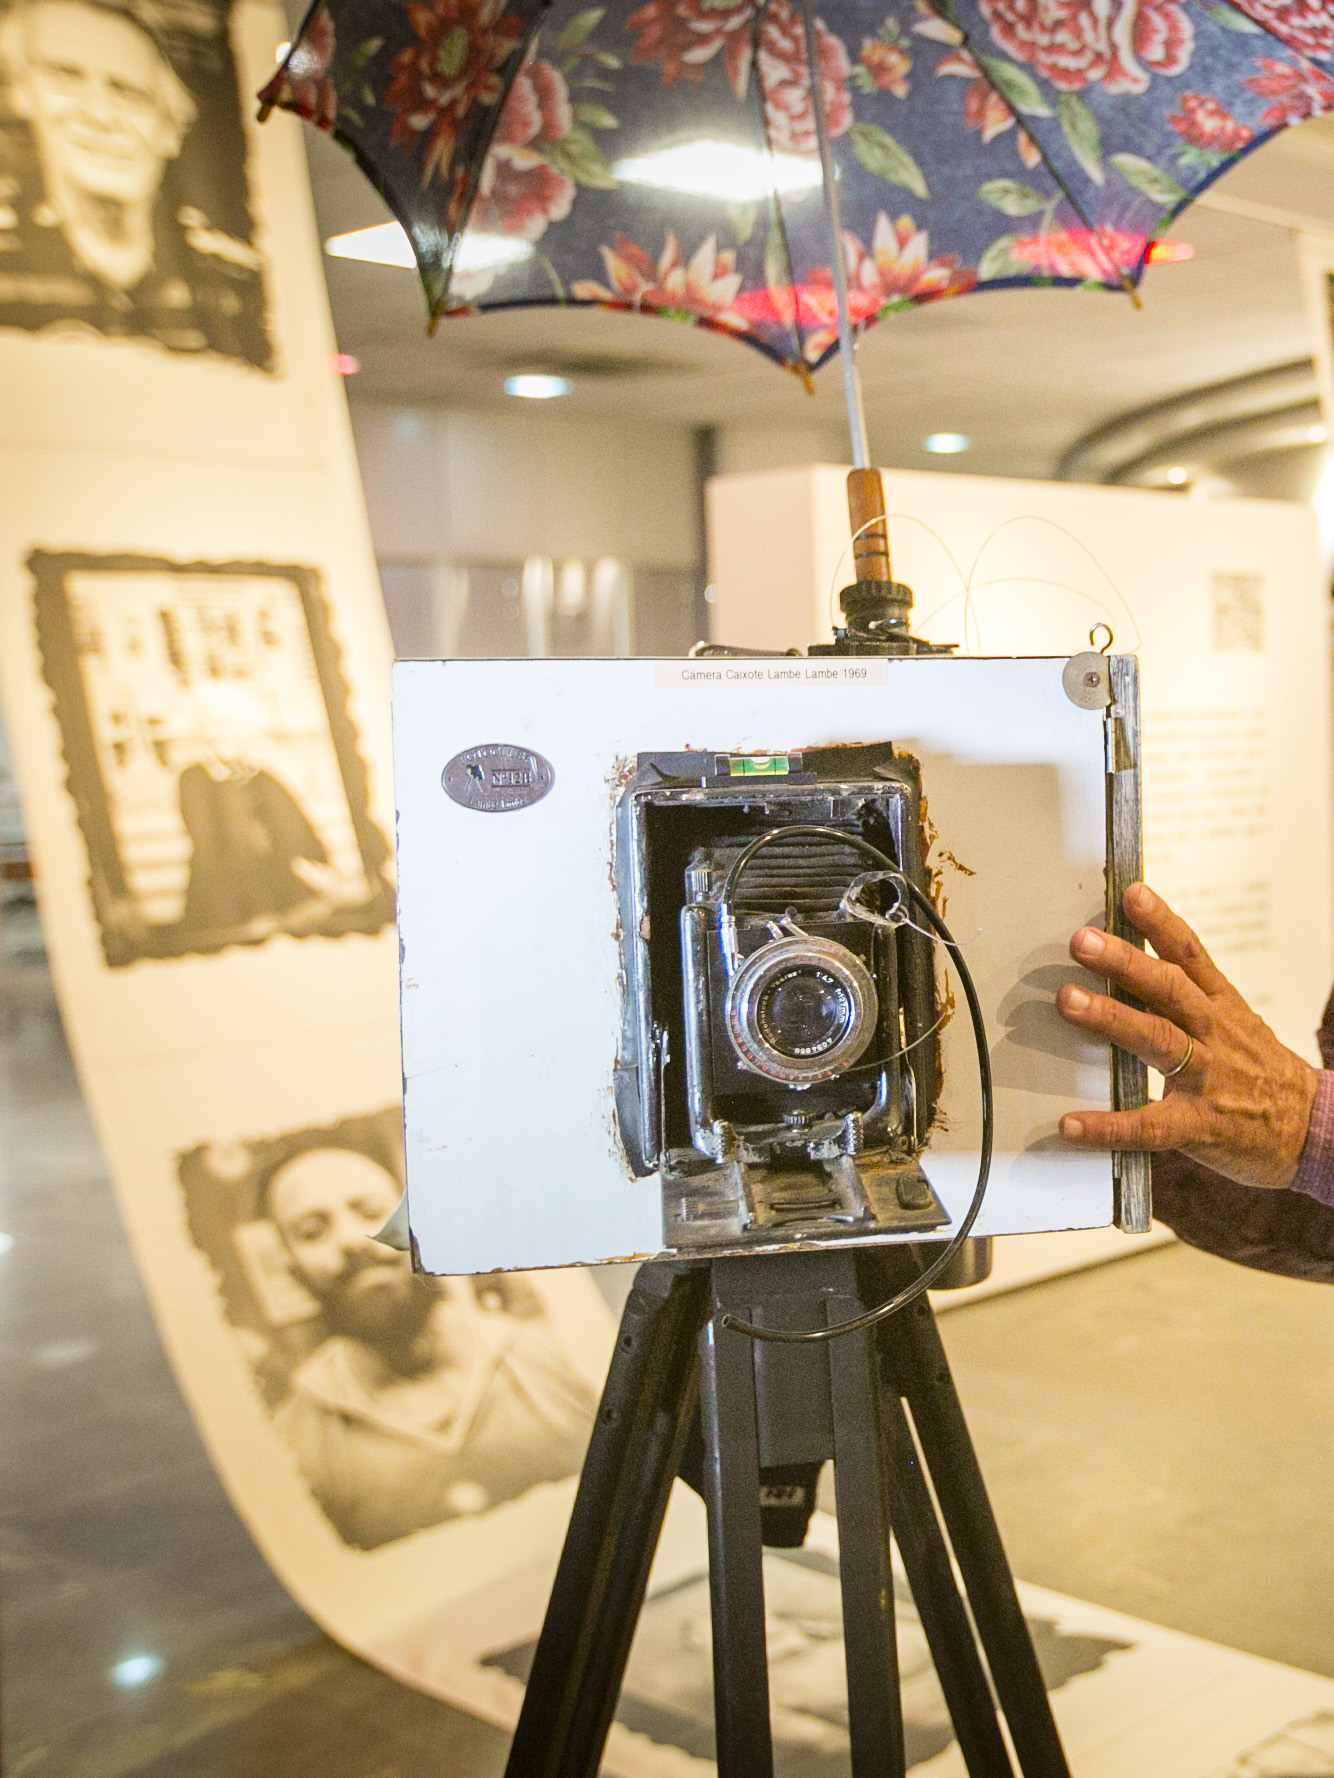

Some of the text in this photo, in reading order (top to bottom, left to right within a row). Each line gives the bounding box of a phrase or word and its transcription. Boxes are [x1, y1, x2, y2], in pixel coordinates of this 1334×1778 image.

[725, 668, 764, 680] Caixote
[767, 668, 801, 679] Lambe
[805, 668, 838, 679] Lambe
[843, 668, 867, 679] 1969
